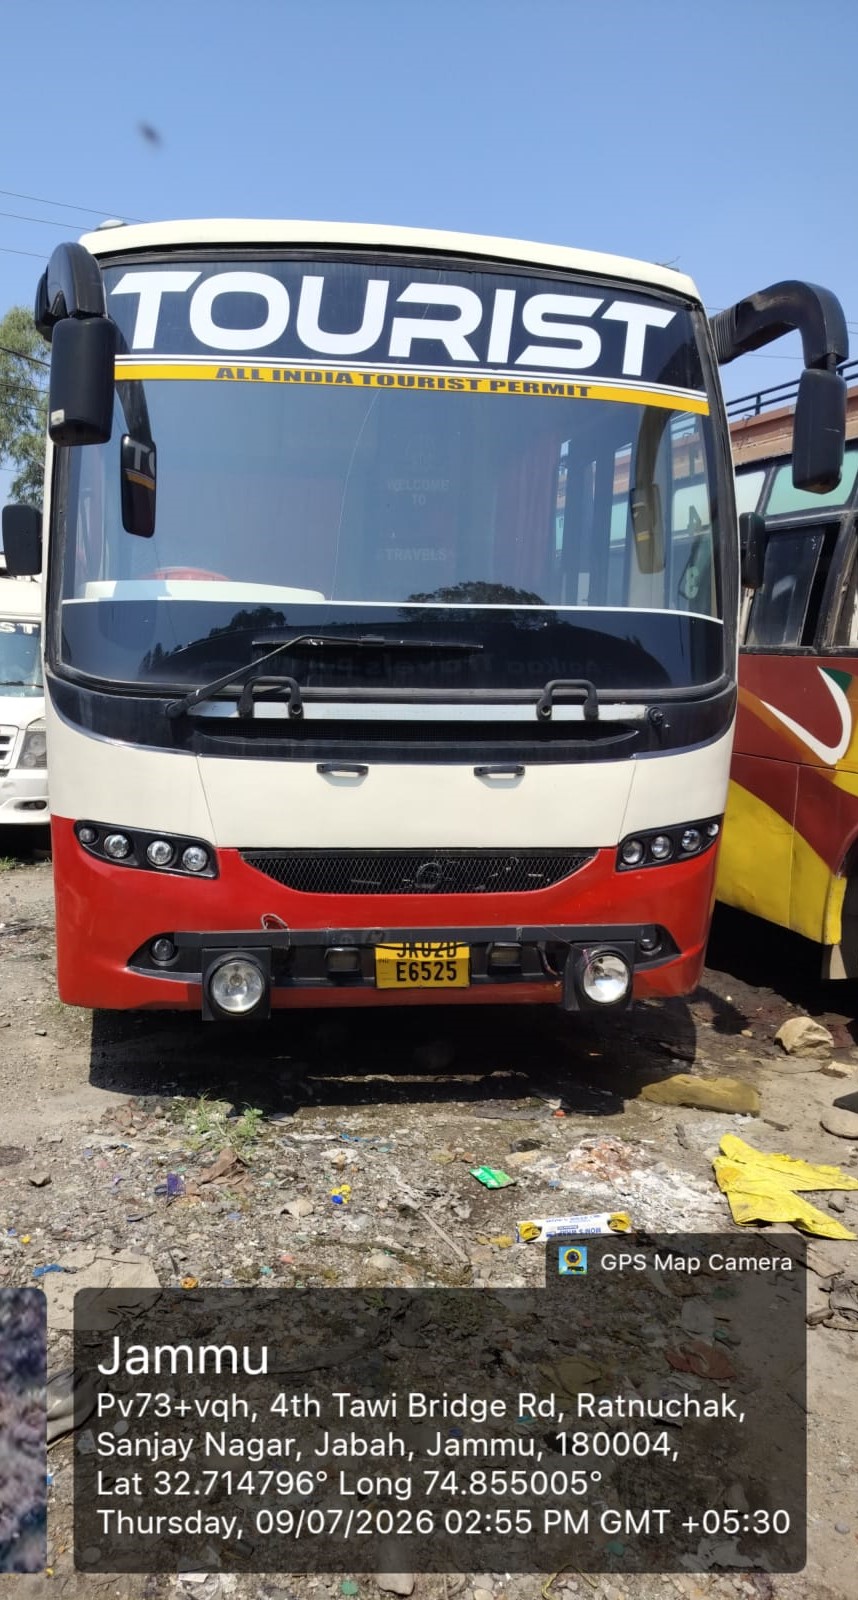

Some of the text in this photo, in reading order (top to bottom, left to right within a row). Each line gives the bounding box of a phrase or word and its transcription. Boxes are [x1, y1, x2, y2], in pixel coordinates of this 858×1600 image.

[110, 271, 678, 377] TOURIST
[215, 367, 592, 397] ALL INDIA TOURIST PERMIT
[411, 493, 427, 506] TO
[396, 961, 457, 981] E6525
